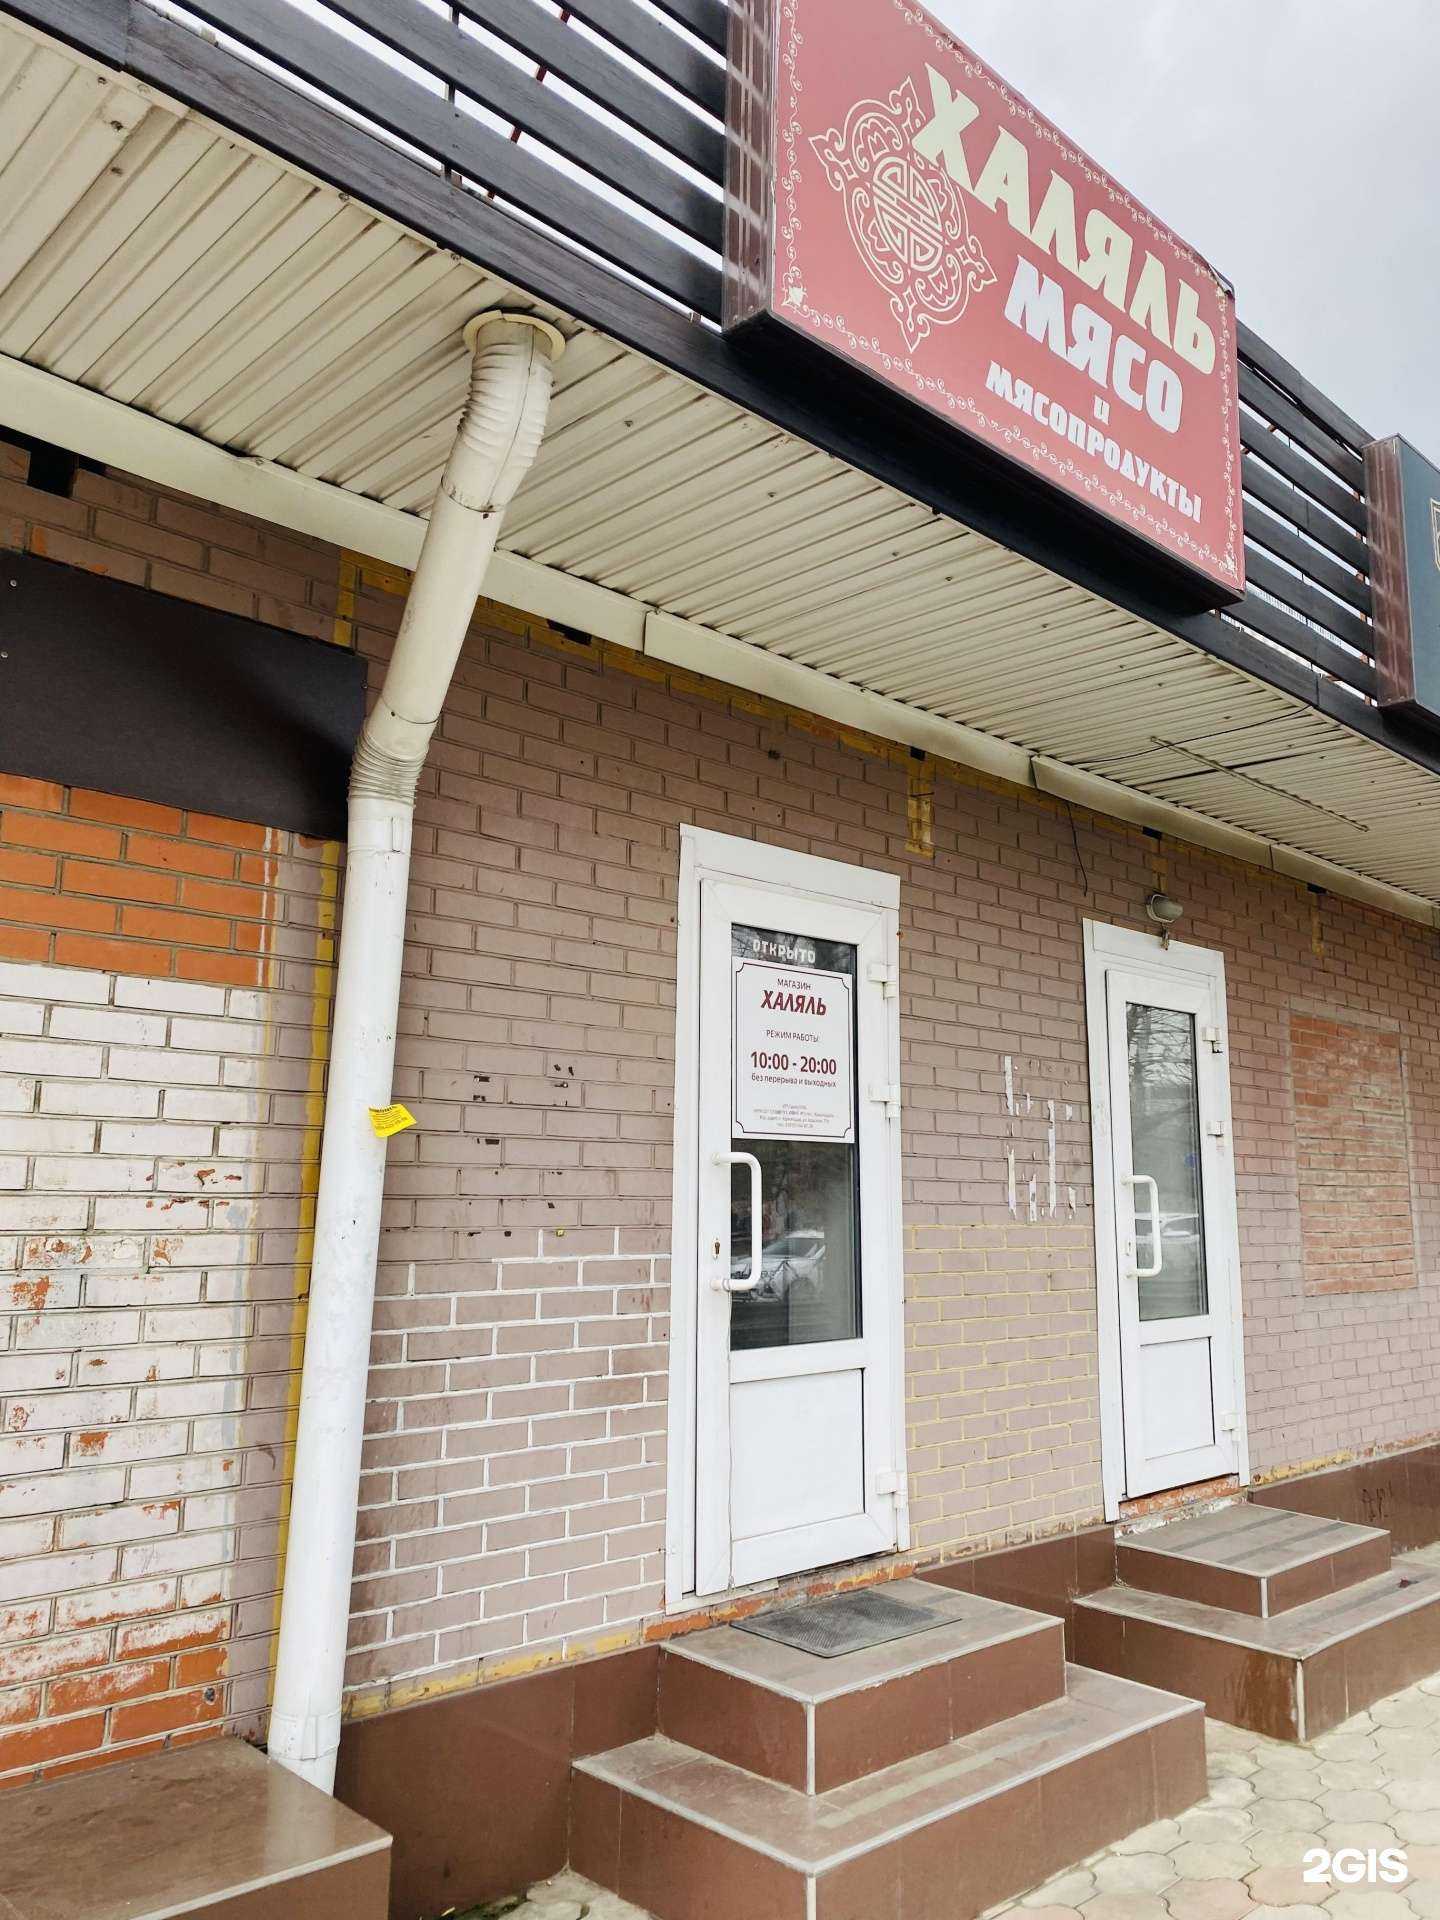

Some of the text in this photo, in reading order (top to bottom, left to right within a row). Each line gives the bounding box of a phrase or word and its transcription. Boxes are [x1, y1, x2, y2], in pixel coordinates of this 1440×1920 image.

[913, 63, 1215, 374] ХАЛЯЛЬ
[1004, 256, 1183, 434] МЯСО
[985, 360, 1202, 525] МЯСОПРОДУКТЫ
[752, 940, 816, 964] ОТКРЫТО
[777, 978, 811, 991] МАГАЗИН
[760, 989, 827, 1016] ХАЛЯЛЬ
[766, 1029, 819, 1043] РЕЖИМ РАБОТЫ
[751, 1051, 789, 1071] 10:00
[800, 1055, 837, 1075] 20:00
[751, 1073, 763, 1082] без
[764, 1075, 797, 1086] перерыва
[804, 1079, 837, 1088] выходных
